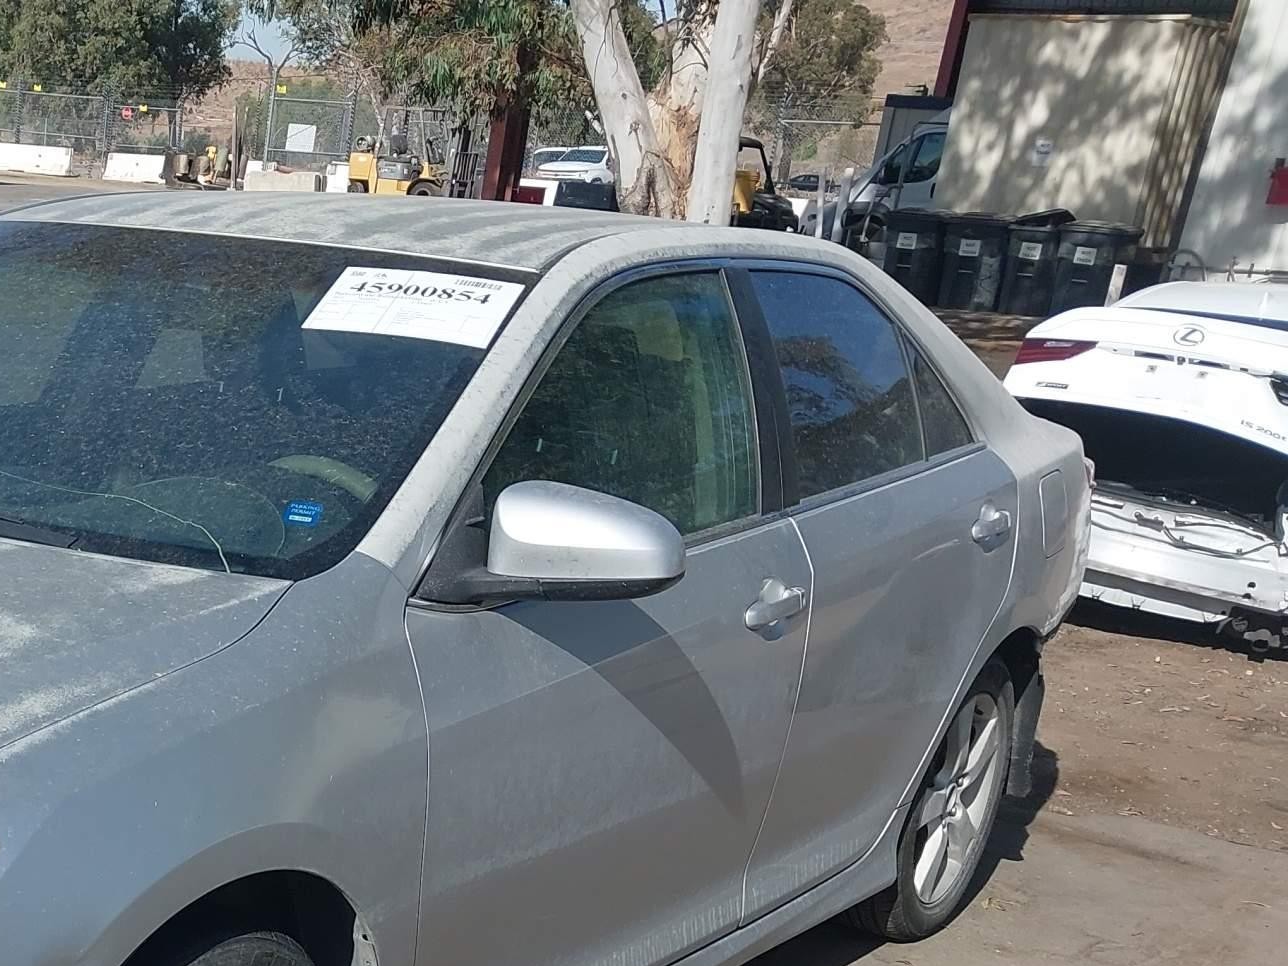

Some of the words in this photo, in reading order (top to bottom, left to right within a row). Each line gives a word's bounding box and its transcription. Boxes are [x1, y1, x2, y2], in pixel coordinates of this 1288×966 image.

[350, 281, 492, 305] 45900854
[291, 503, 321, 512] PARKING
[291, 508, 316, 516] PERMIT
